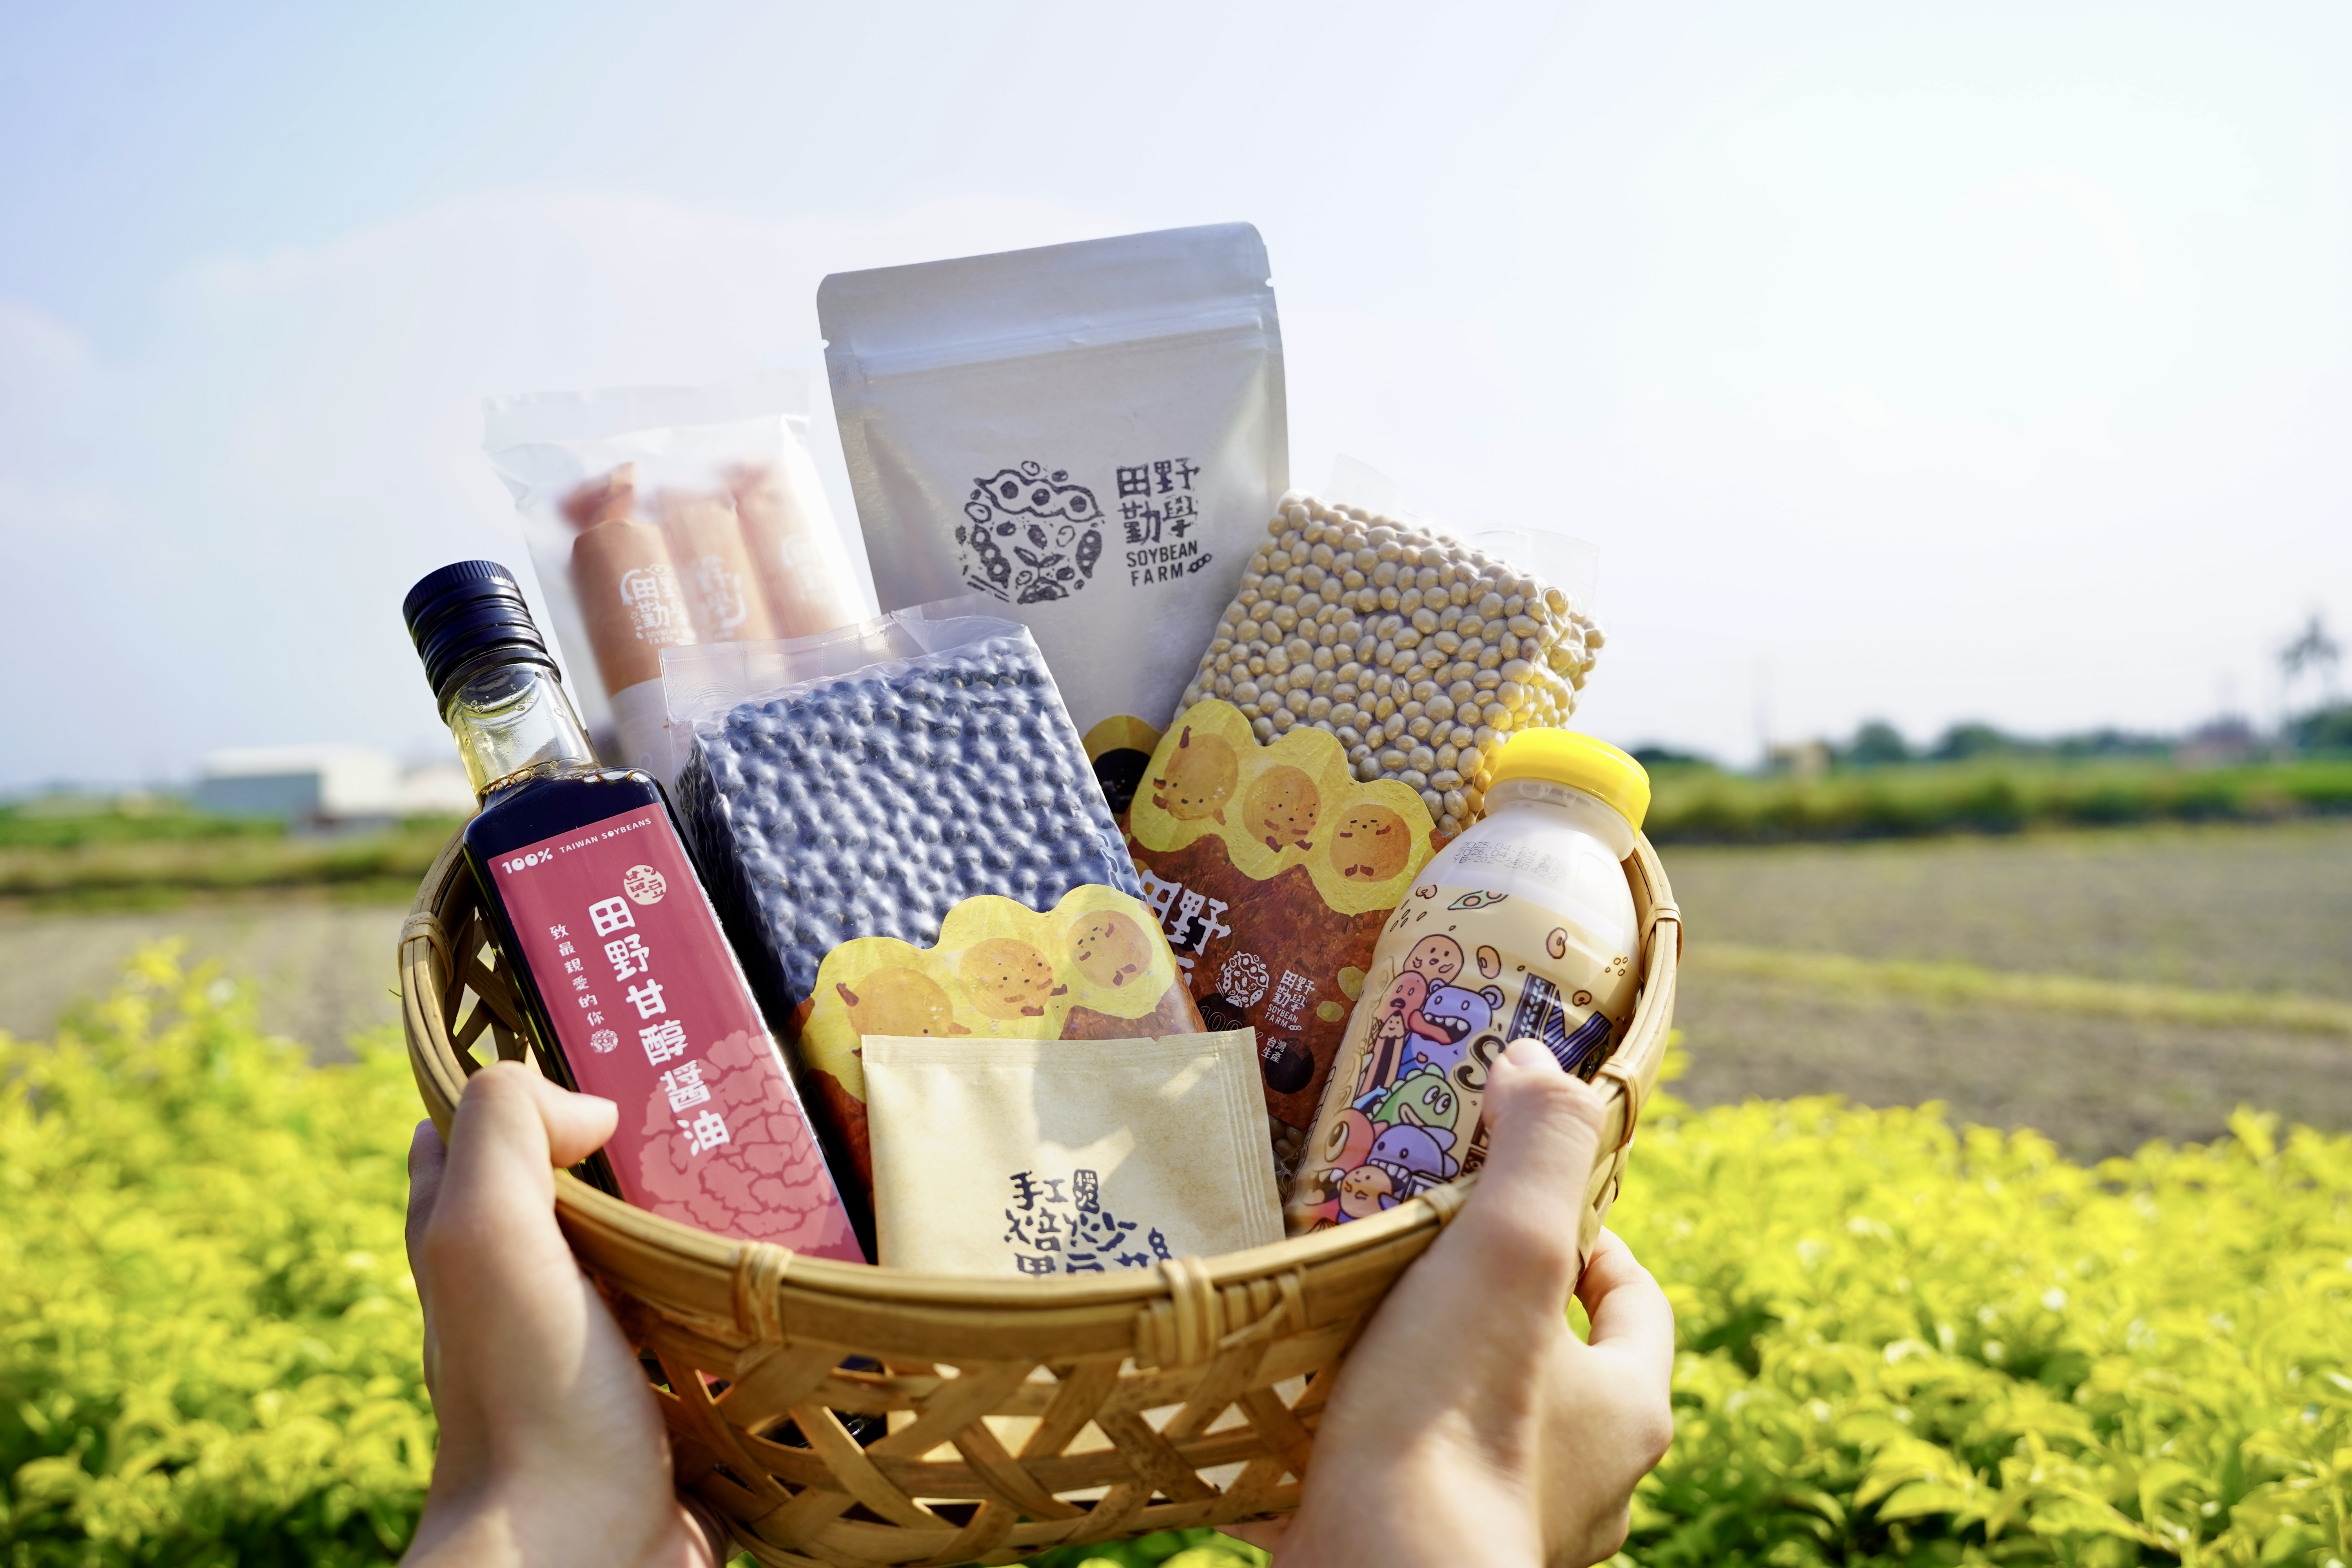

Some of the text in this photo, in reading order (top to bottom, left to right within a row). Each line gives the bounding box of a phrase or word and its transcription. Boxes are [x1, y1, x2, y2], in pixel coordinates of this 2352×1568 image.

[1117, 458, 1200, 499] 田野
[1118, 495, 1198, 545] 勤學
[1126, 540, 1198, 568] SOYBEAN
[1131, 562, 1183, 587] FARM
[649, 635, 674, 646] FARM
[502, 818, 652, 874] 100% TAIWAN SOYBEANS
[1459, 842, 1537, 857] 2025.04.24
[549, 924, 605, 1027] 致最親愛的你
[1280, 969, 1315, 996] 田野
[1272, 984, 1307, 1013] 勤學
[588, 896, 731, 1157] 田野甘醇醬油
[1265, 1012, 1288, 1028] FARM
[1267, 1004, 1298, 1023] SOYBEAN
[1261, 1047, 1282, 1063] 生產
[1267, 1036, 1287, 1053] 台灣
[1010, 1170, 1069, 1210] 手工
